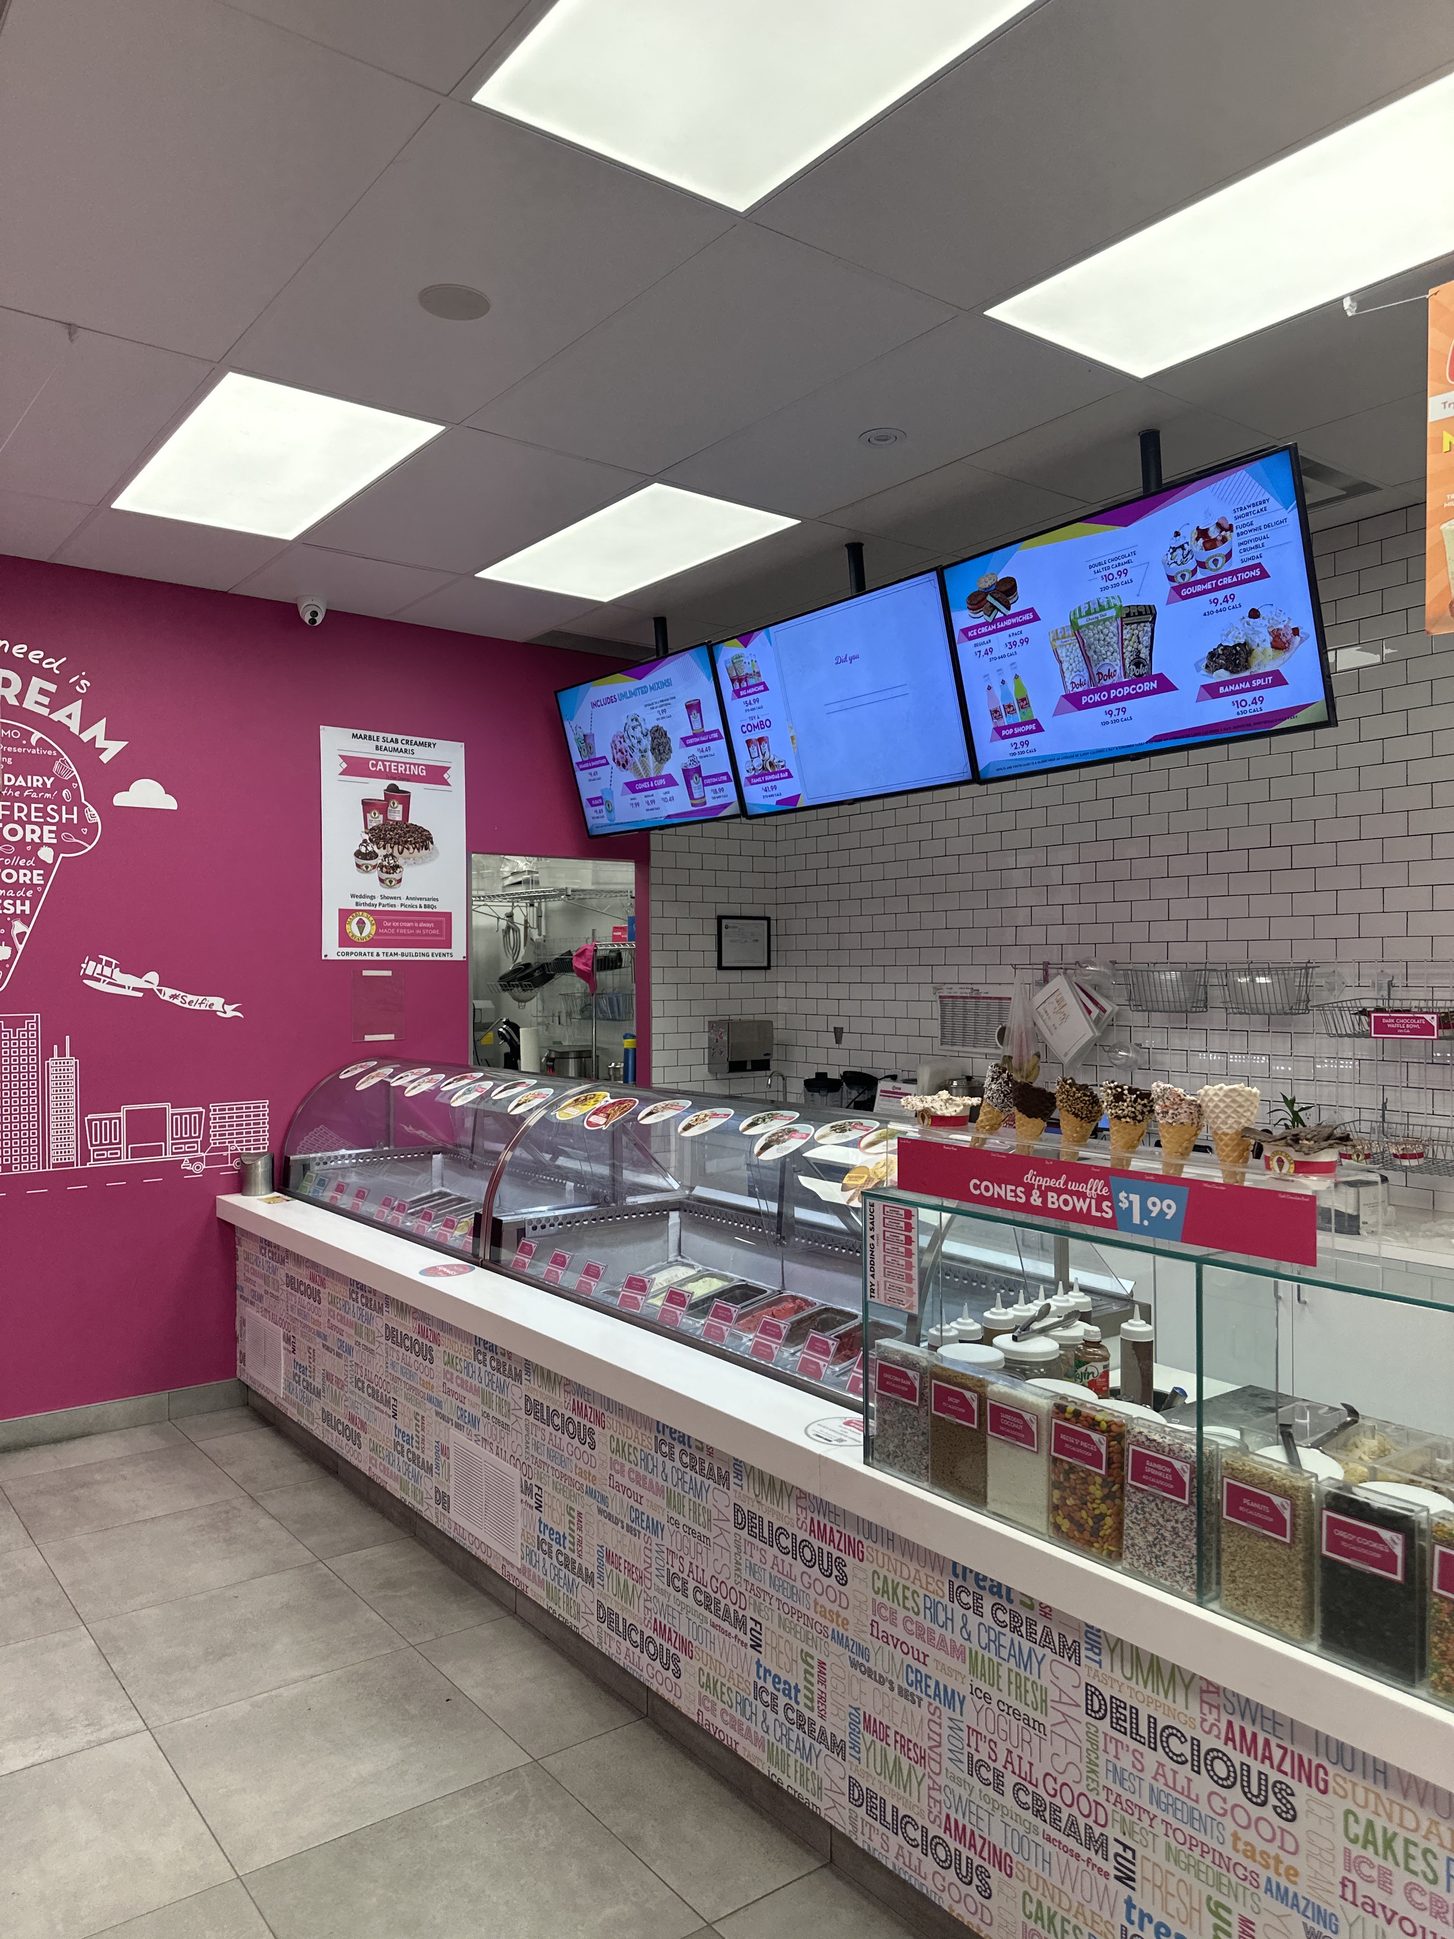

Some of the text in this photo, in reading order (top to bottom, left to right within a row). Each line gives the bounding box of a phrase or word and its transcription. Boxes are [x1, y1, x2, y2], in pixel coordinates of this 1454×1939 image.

[1233, 498, 1270, 513] STRAWBERRY
[1234, 506, 1267, 520] SHORTCAKE
[1235, 521, 1254, 530] FUDGE
[1236, 518, 1288, 537] BROWNIE DELIGHT
[1237, 534, 1270, 547] INDIVIDUAL
[1089, 551, 1136, 569] DOUBLE CHOCOLATE
[1239, 542, 1265, 553] CRUMBLE
[1240, 553, 1262, 564] SUNDAE
[1093, 559, 1133, 574] SALTED CARAMEL
[1101, 568, 1128, 582] $10.99
[1181, 568, 1261, 596] GOURMET CREATIONS
[1209, 593, 1236, 607] $9.49
[968, 612, 1033, 637] ICE CREAM SANDWICHES
[834, 653, 860, 665] Did you
[974, 647, 993, 659] $7.49
[1005, 637, 1030, 650] $39.99
[0, 639, 90, 693] need is
[591, 694, 618, 709] INCLUDES
[617, 685, 649, 701] UNLIMITED
[1082, 680, 1158, 705] POKO POPCORN
[1219, 676, 1272, 693] BANANA SPLIT
[1104, 706, 1127, 718] $9.79
[1232, 695, 1264, 709] $10.49
[352, 733, 437, 749] MARBLE SLAB CREAMERY
[740, 719, 772, 734] COMBO
[1001, 723, 1037, 736] POP SHOPPE
[375, 745, 415, 755] BEAUMARIS
[1010, 739, 1030, 751] $2.99
[4, 774, 55, 788] DAIRY
[369, 760, 426, 776] CATERING
[24, 789, 58, 799] Farm!
[169, 990, 215, 1010] #Selfie
[969, 1178, 1113, 1219] CONES & BOWLS
[1023, 1169, 1110, 1199] dipped waffle
[1118, 1191, 1177, 1226] $1.99
[285, 1273, 321, 1305] DELICIOUS
[385, 1323, 434, 1365] DELICIOUS
[524, 1394, 596, 1451] DELICIOUS
[571, 1399, 606, 1431] AMAZING
[609, 1435, 638, 1467] CAKES
[654, 1439, 730, 1491] ICE CREAM
[1146, 1460, 1172, 1473] RAINBOW
[608, 1473, 643, 1506] flavour
[1145, 1466, 1173, 1481] SPRINKLES
[1242, 1498, 1270, 1512] PEANUTS
[538, 1519, 567, 1550] treat
[629, 1504, 665, 1541] CREAMY
[734, 1502, 848, 1587] DELICIOUS
[809, 1516, 865, 1562] AMAZING
[666, 1547, 747, 1612] IT'S ALL GOOD
[872, 1569, 920, 1618] CAKES
[813, 1600, 849, 1631] taste
[949, 1579, 1082, 1667] ICE CREAM
[596, 1599, 681, 1680] DELICIOUS
[870, 1620, 930, 1667] flavour
[924, 1594, 1046, 1680] RICH & CREAMY
[755, 1658, 800, 1706] treat
[848, 1655, 923, 1708] WORLD'S BEST
[905, 1663, 966, 1717] CREAMY
[969, 1680, 1047, 1737] ice cream
[863, 1711, 927, 1770] MADE FRESH
[1084, 1682, 1297, 1823] DELICIOUS
[1085, 1721, 1100, 1797] CUPCAKES
[1223, 1719, 1329, 1795] AMAZING
[967, 1751, 1109, 1862] ICE CREAM
[1102, 1731, 1299, 1857] IT'S ALL GOOD
[848, 1776, 993, 1899] DELICIOUS
[943, 1813, 1014, 1879] AMAZING
[1102, 1785, 1261, 1889] TASTY TOPPINGS
[1343, 1808, 1439, 1885] CAKES
[1042, 1828, 1110, 1881] lactose-free
[1113, 1837, 1136, 1891] FUN
[1231, 1829, 1300, 1886] taste
[1264, 1875, 1339, 1936] AMAZING
